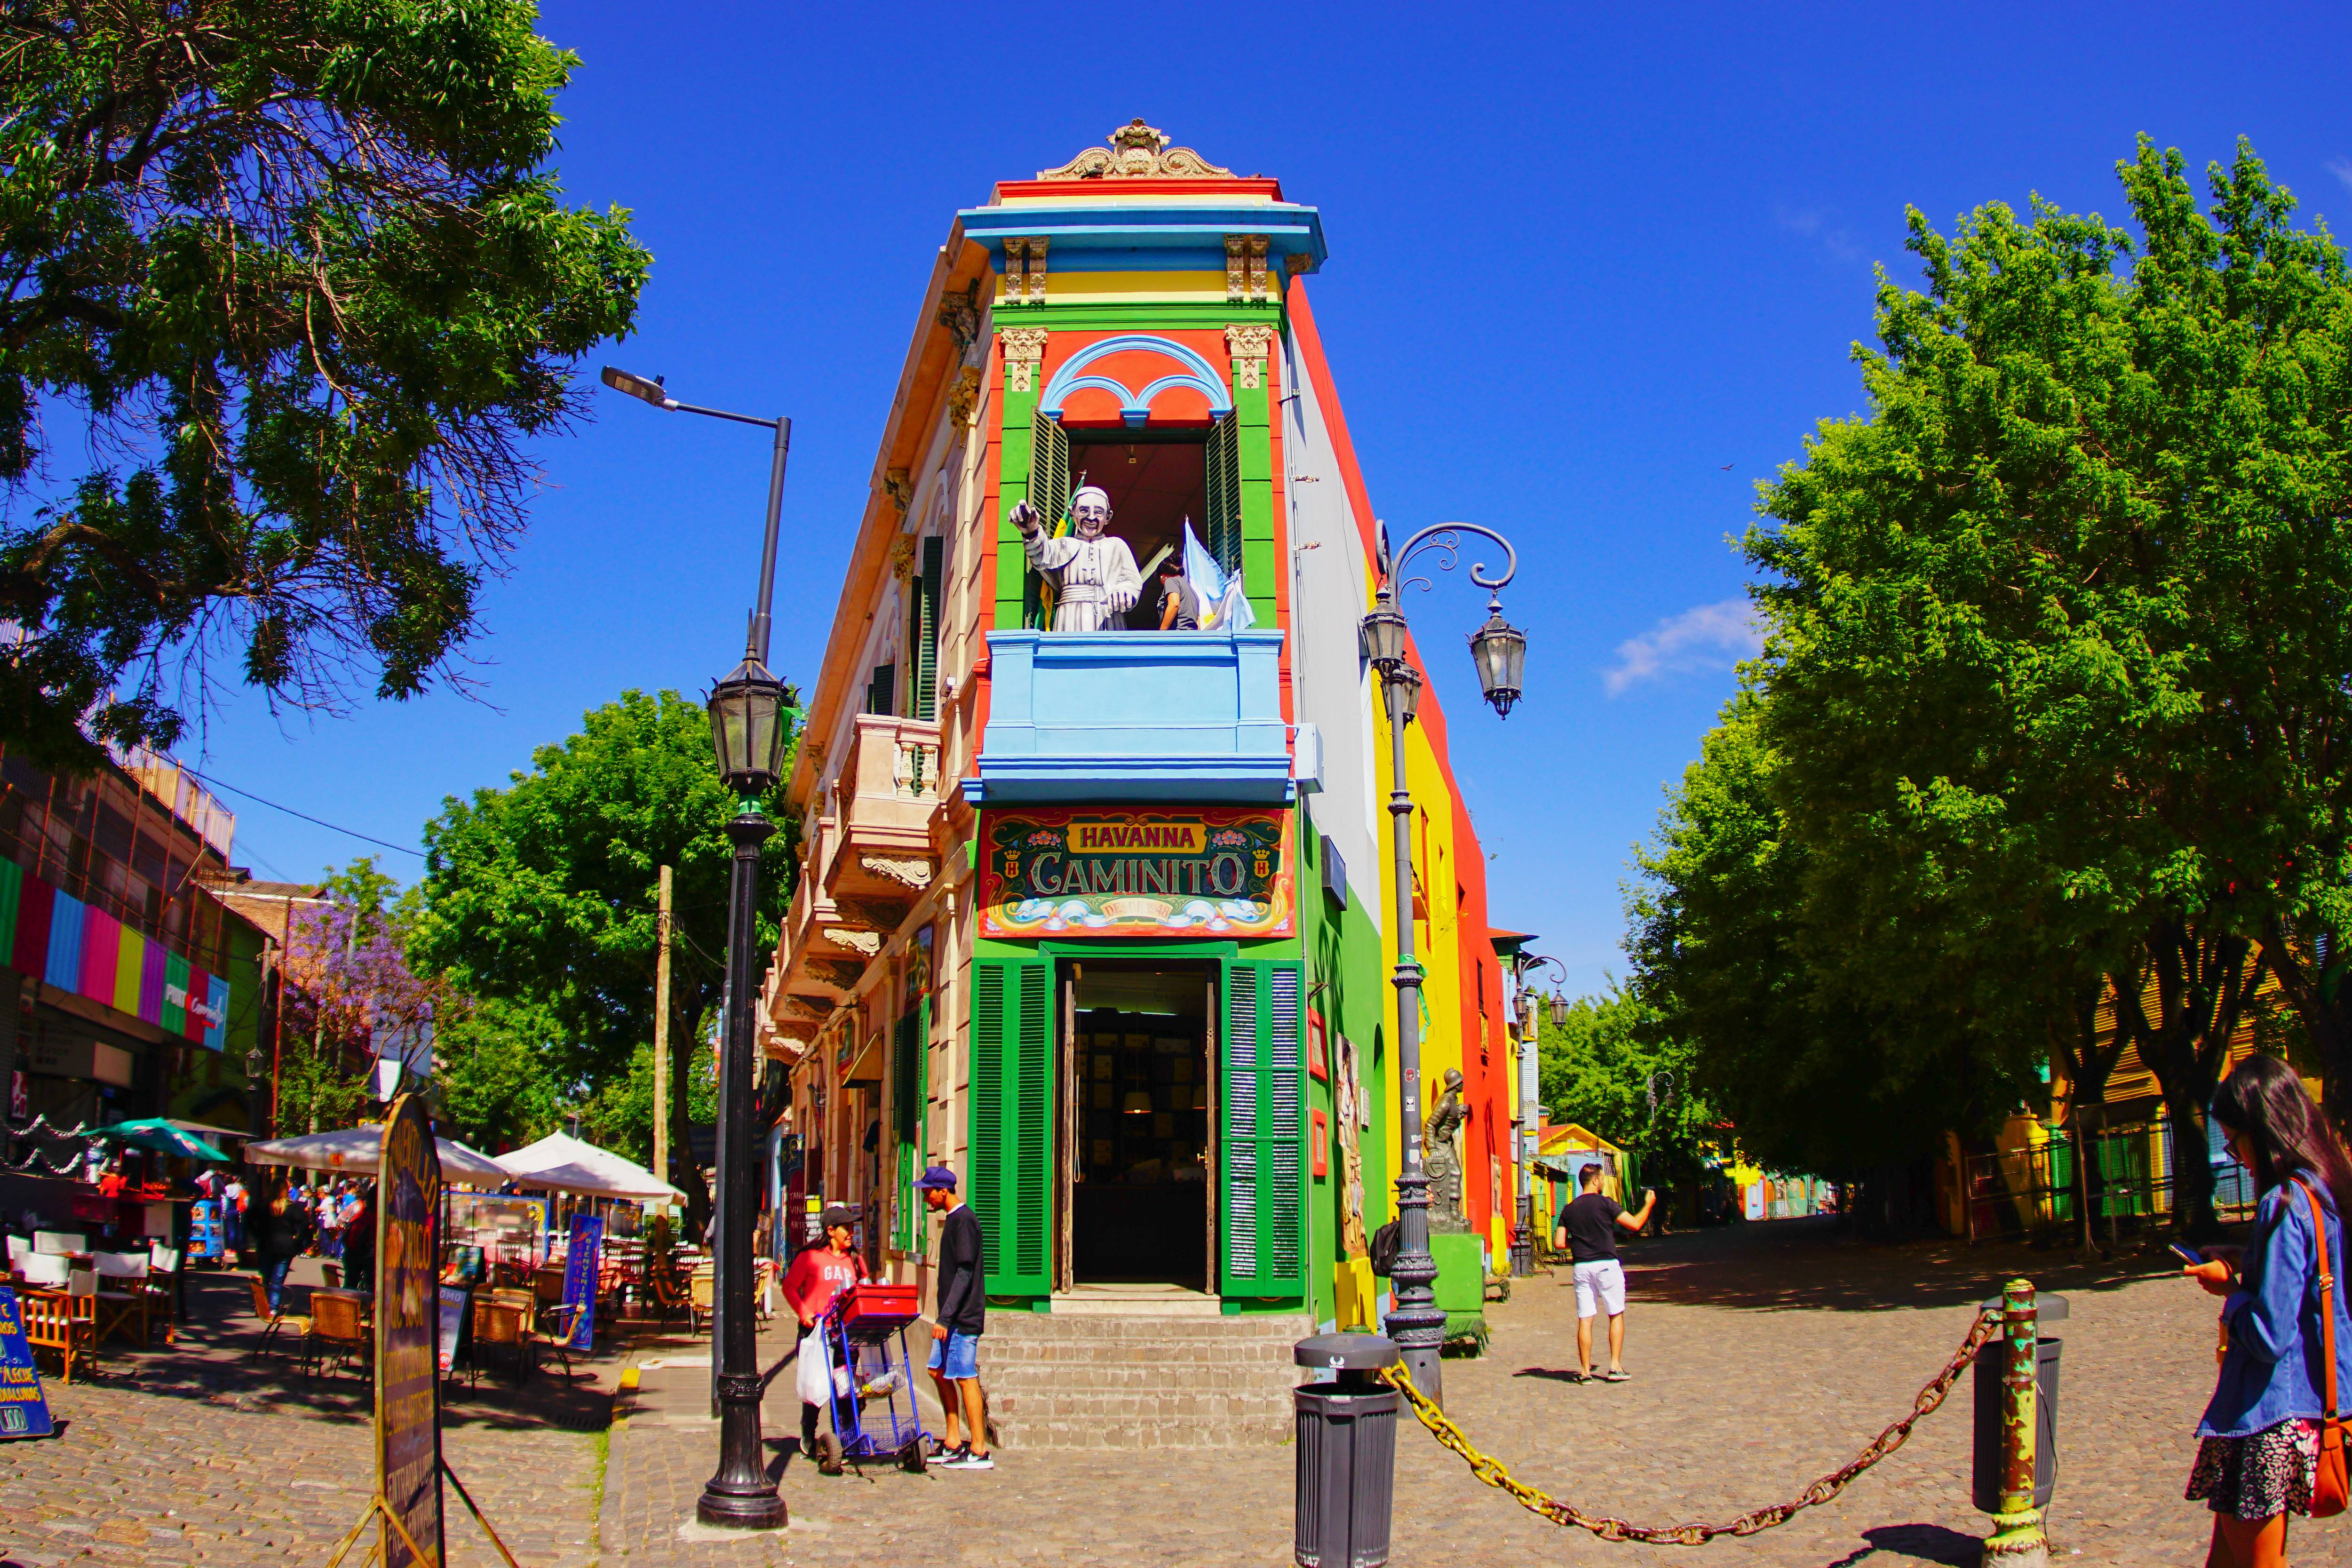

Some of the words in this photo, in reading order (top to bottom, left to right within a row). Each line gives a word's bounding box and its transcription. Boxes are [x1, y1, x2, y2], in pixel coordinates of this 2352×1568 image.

[1080, 827, 1195, 848] HAVANNA
[1008, 861, 1017, 875] H
[1030, 852, 1246, 895] CAMINITO
[1257, 862, 1266, 874] H
[1104, 901, 1145, 917] DESDE
[1147, 902, 1170, 917] 1948
[824, 1265, 852, 1281] GAP
[440, 1290, 461, 1302] OMO
[387, 1461, 419, 1506] ENTRADA
[1303, 1555, 1319, 1568] 147
